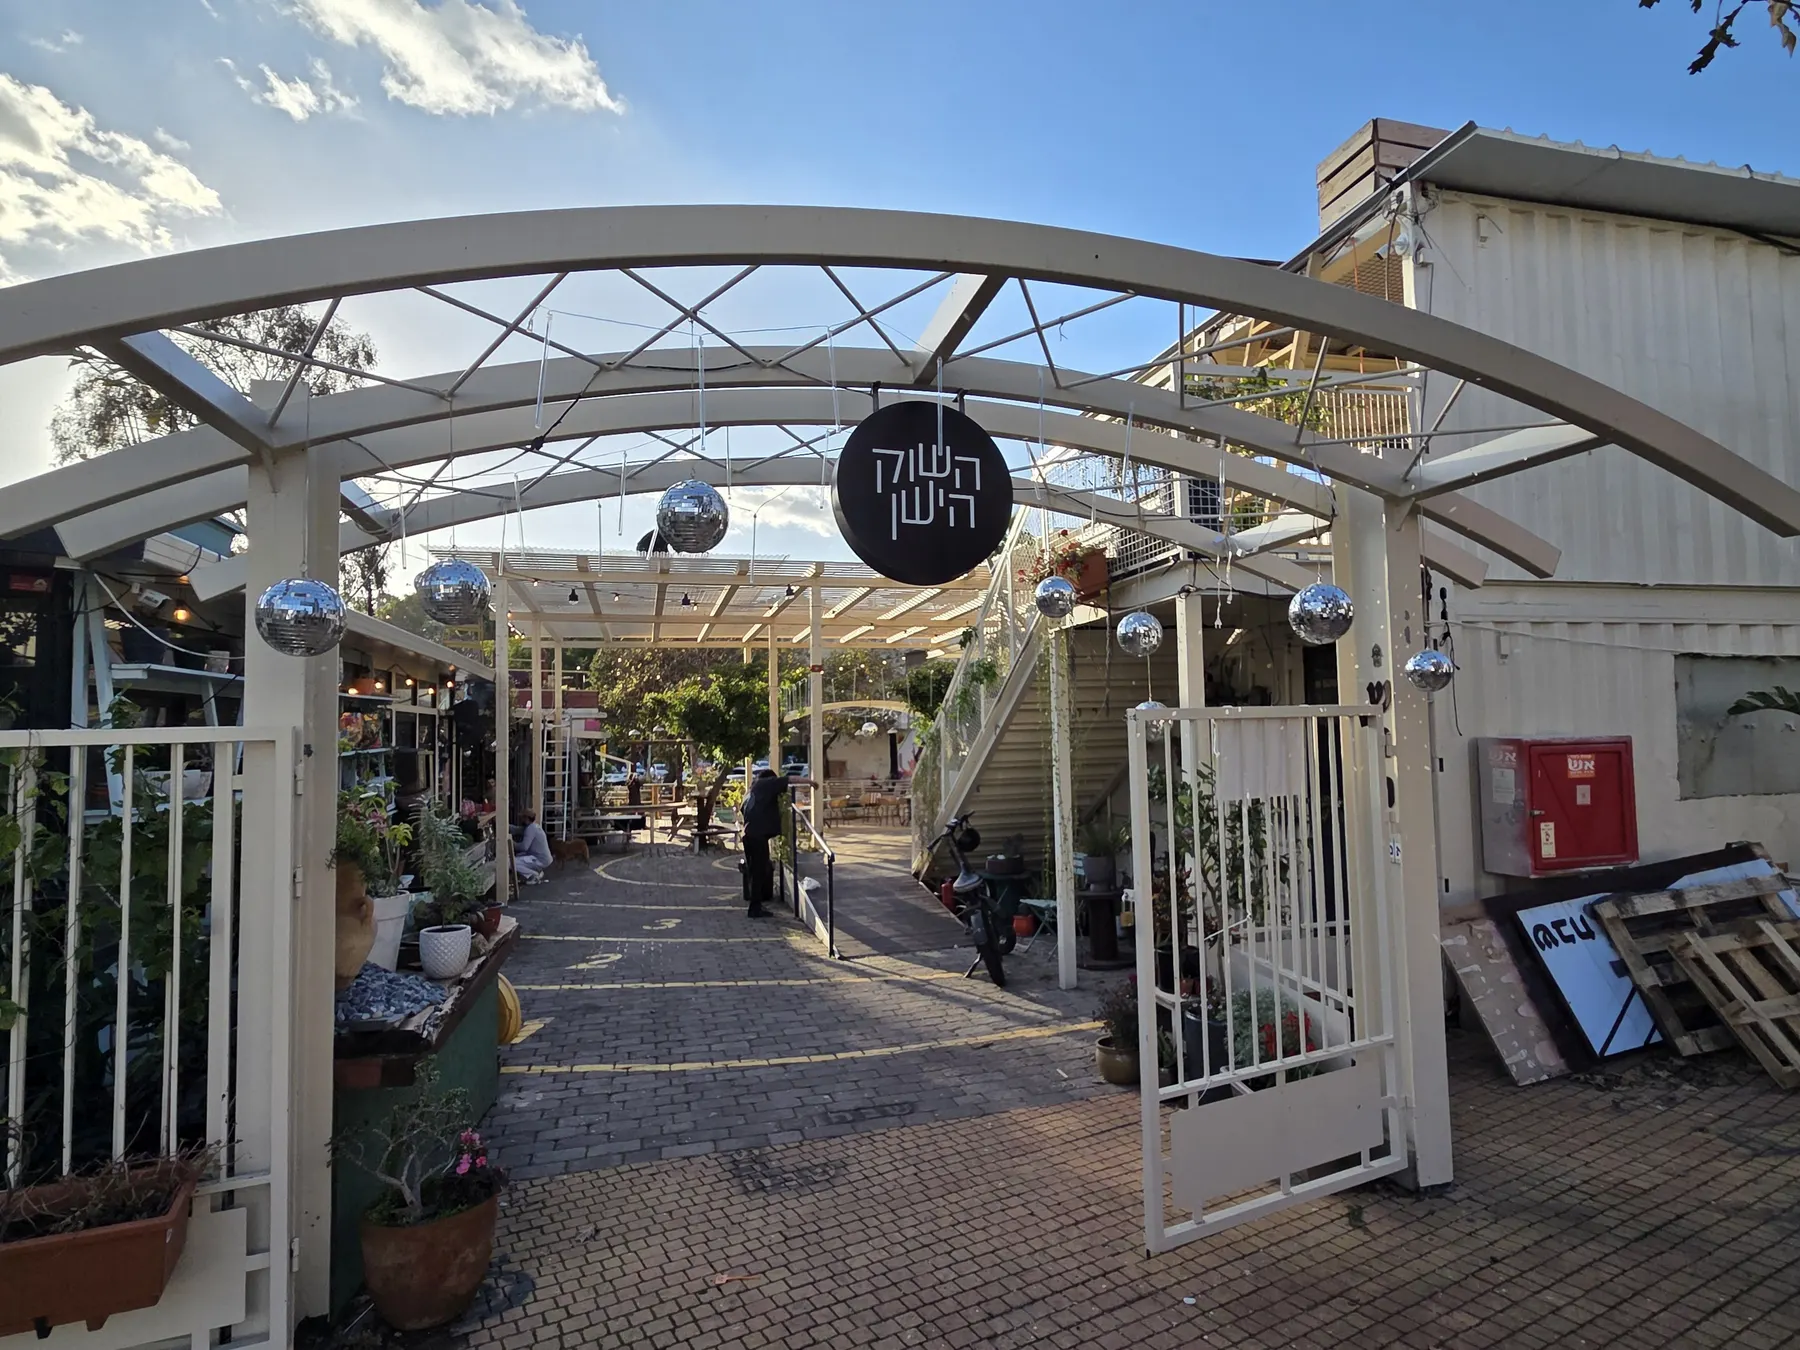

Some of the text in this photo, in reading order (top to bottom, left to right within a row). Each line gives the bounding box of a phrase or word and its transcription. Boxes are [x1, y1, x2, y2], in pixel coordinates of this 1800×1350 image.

[872, 442, 981, 494] השוק
[891, 480, 976, 541] הישן
[1567, 757, 1596, 772] אש
[565, 953, 623, 970] 2
